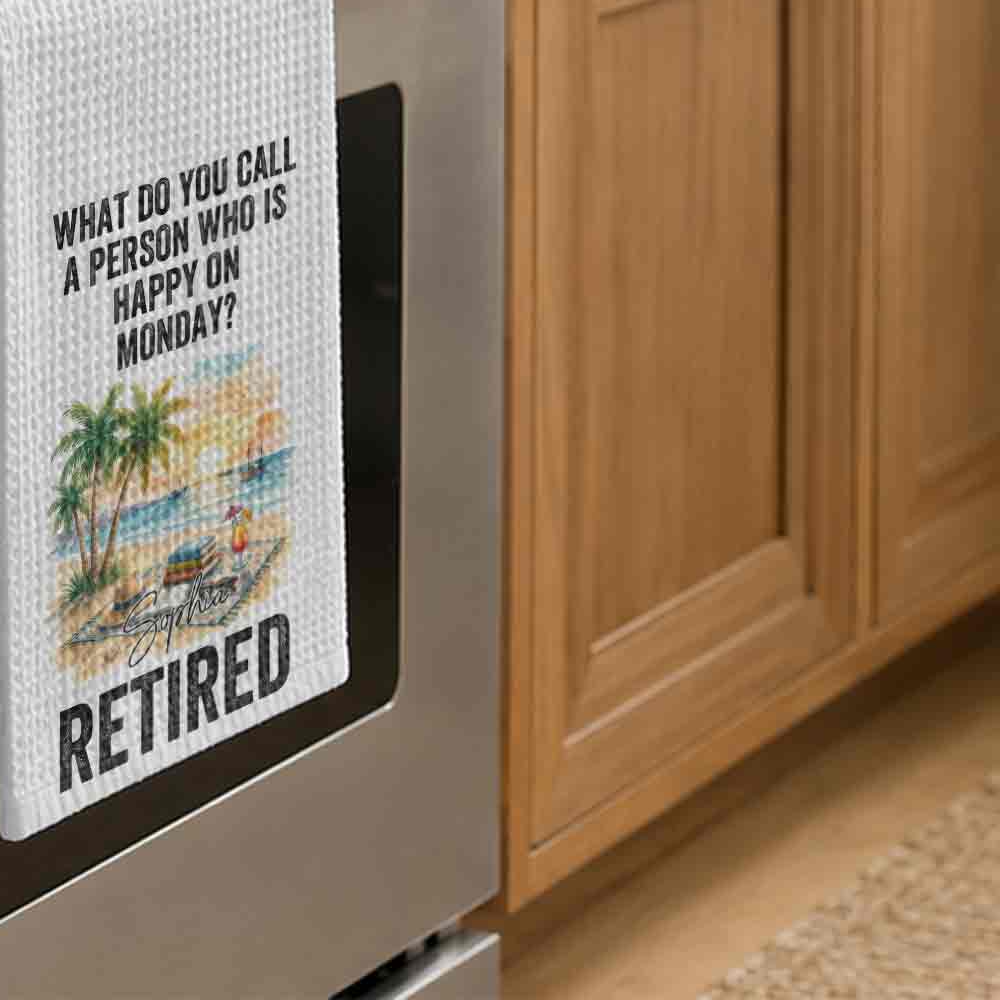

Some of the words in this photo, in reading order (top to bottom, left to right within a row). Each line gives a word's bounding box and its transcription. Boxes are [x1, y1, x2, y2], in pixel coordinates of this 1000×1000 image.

[53, 190, 130, 250] WHAT
[138, 177, 171, 223] DO
[179, 157, 228, 207] YOU
[237, 135, 297, 187] CALL
[63, 256, 80, 296] A
[89, 216, 189, 287] PERSON
[198, 195, 256, 246] WHO
[264, 183, 287, 224] IS
[113, 259, 198, 325] HAPPY
[206, 245, 240, 289] ON
[116, 292, 237, 371] MONDAY?
[59, 613, 290, 793] RETIRED
